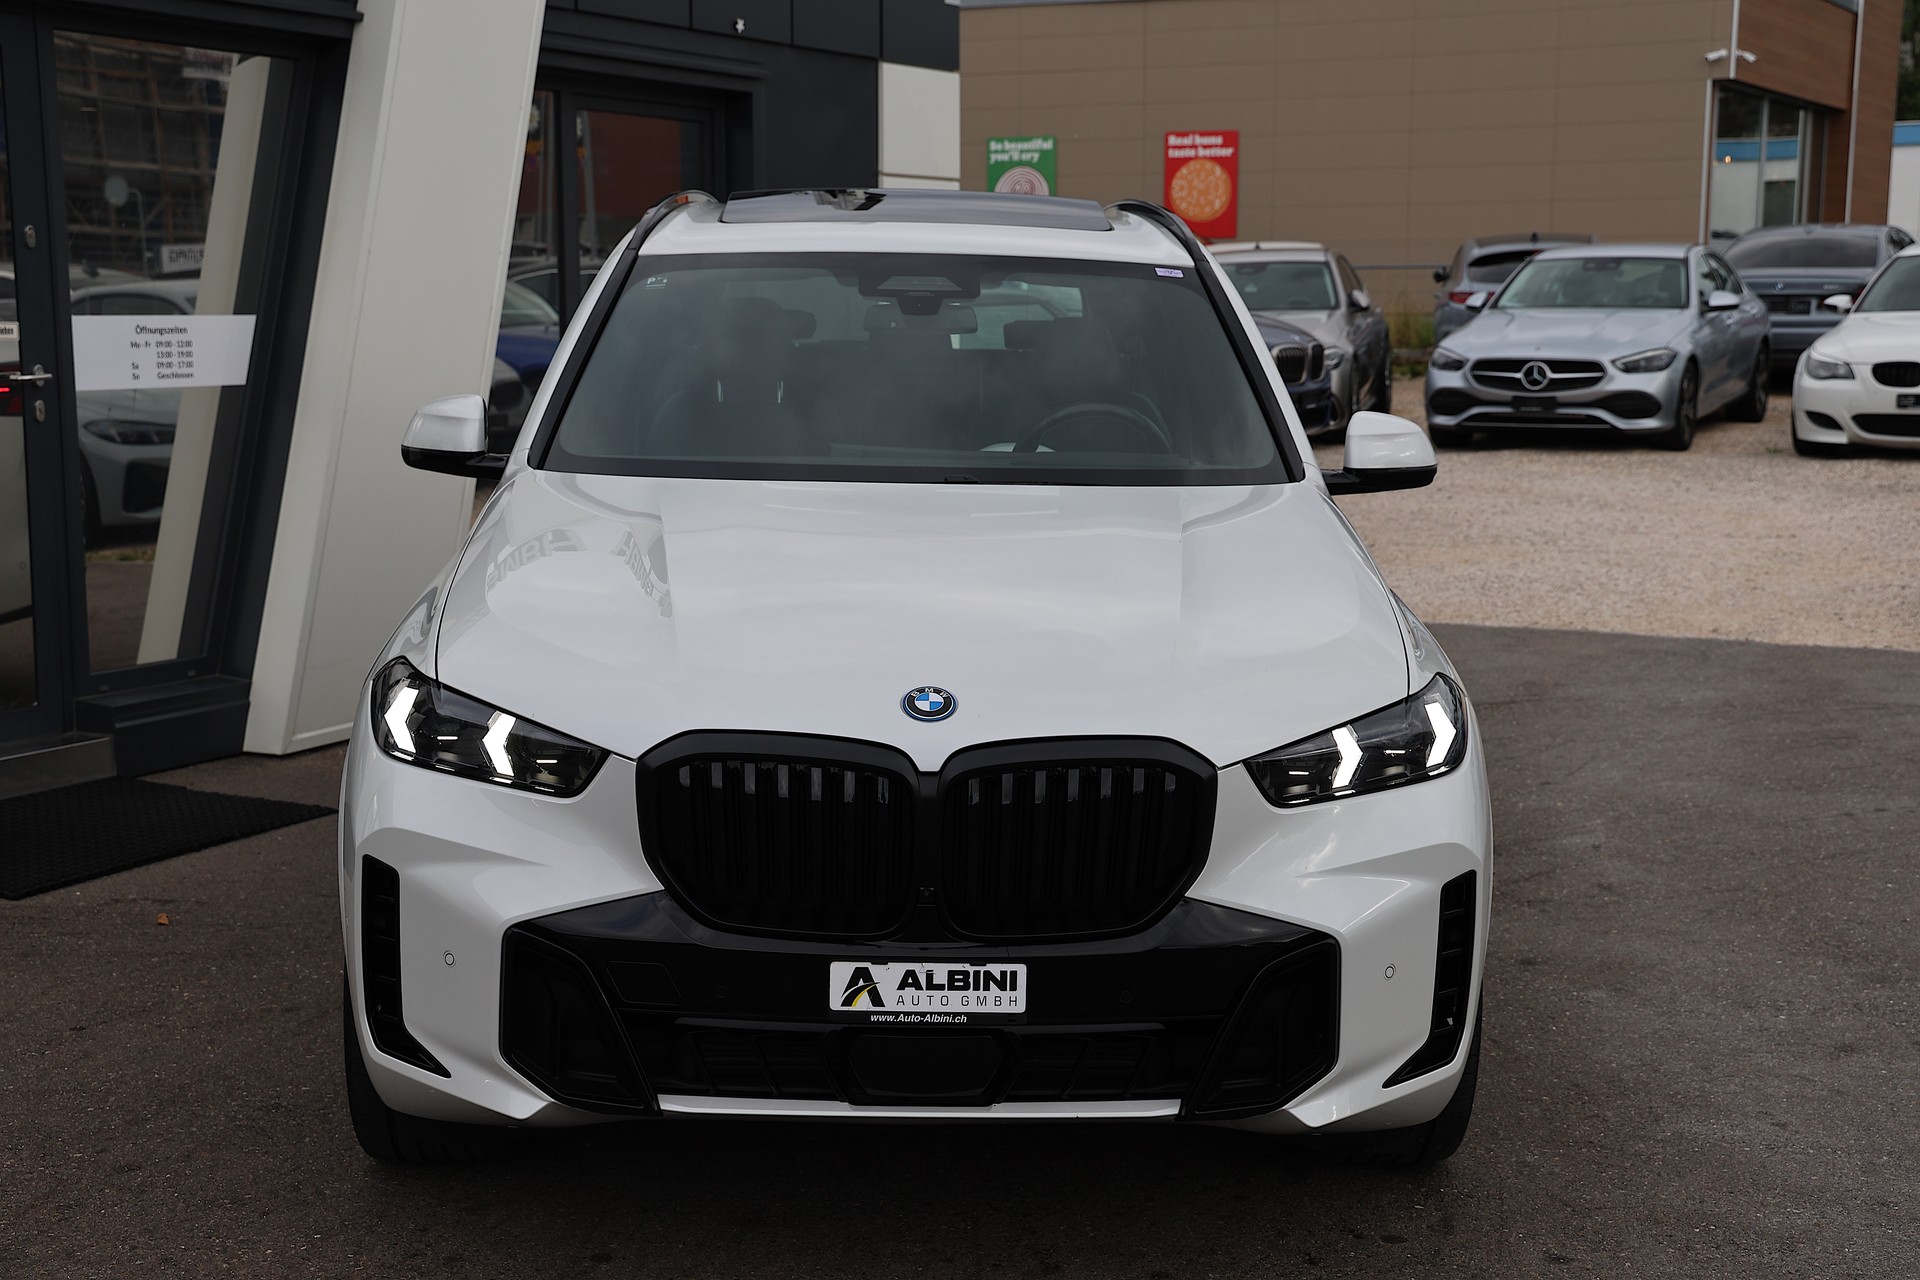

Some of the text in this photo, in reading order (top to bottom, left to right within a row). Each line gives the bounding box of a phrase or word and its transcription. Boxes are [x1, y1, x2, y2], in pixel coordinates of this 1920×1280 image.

[1003, 137, 1053, 151] beautiful
[1168, 133, 1224, 146] Real buns
[1021, 151, 1040, 164] cry
[1168, 145, 1235, 159] taste better
[135, 324, 188, 336] Öffnungszeiten
[157, 371, 195, 380] Geschlossen
[910, 687, 949, 698] BMW
[896, 969, 1018, 992] ALBINI
[896, 995, 1018, 1007] AUTO GMBH
[870, 1013, 968, 1024] www.Auto-Albini.ch
